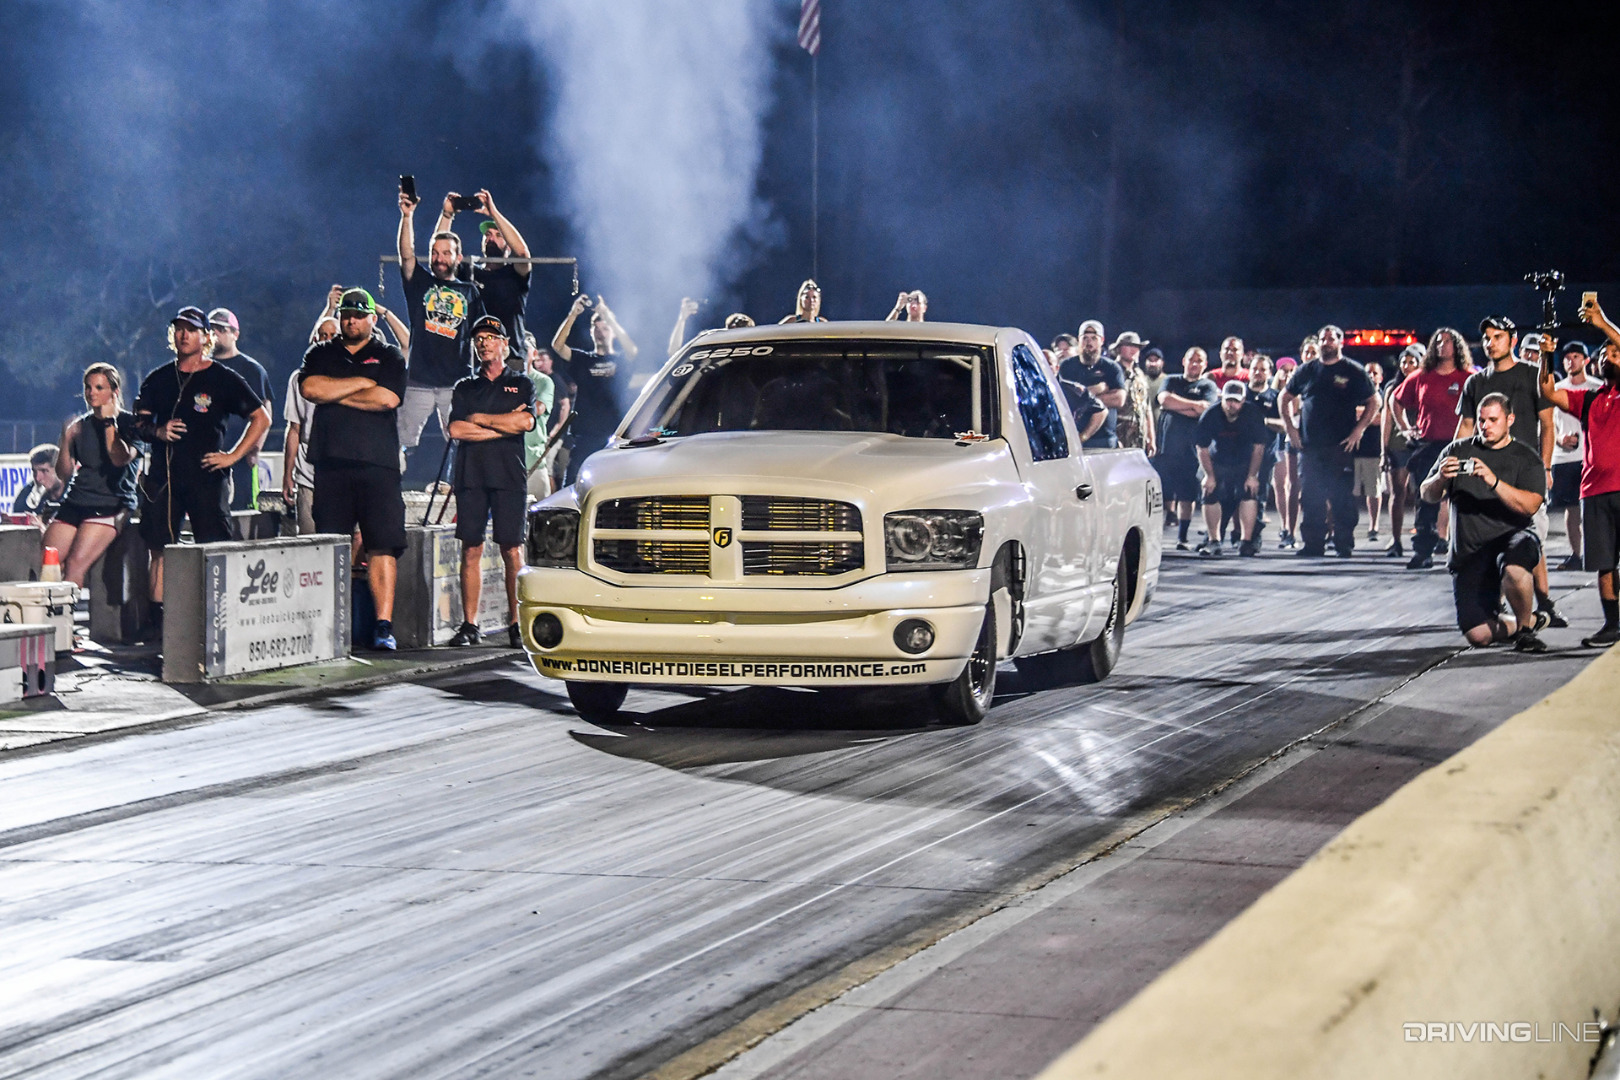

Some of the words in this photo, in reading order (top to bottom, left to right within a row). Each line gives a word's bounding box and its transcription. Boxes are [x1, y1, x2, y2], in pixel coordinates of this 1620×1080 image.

[503, 386, 519, 394] TVC
[239, 558, 279, 604] Lee
[299, 571, 323, 588] GMC
[212, 565, 220, 667] OFFICIAL
[248, 633, 313, 662] 850-682-2700
[541, 656, 927, 678] www.DONERIGHTDIESELPERFORMANCE.com
